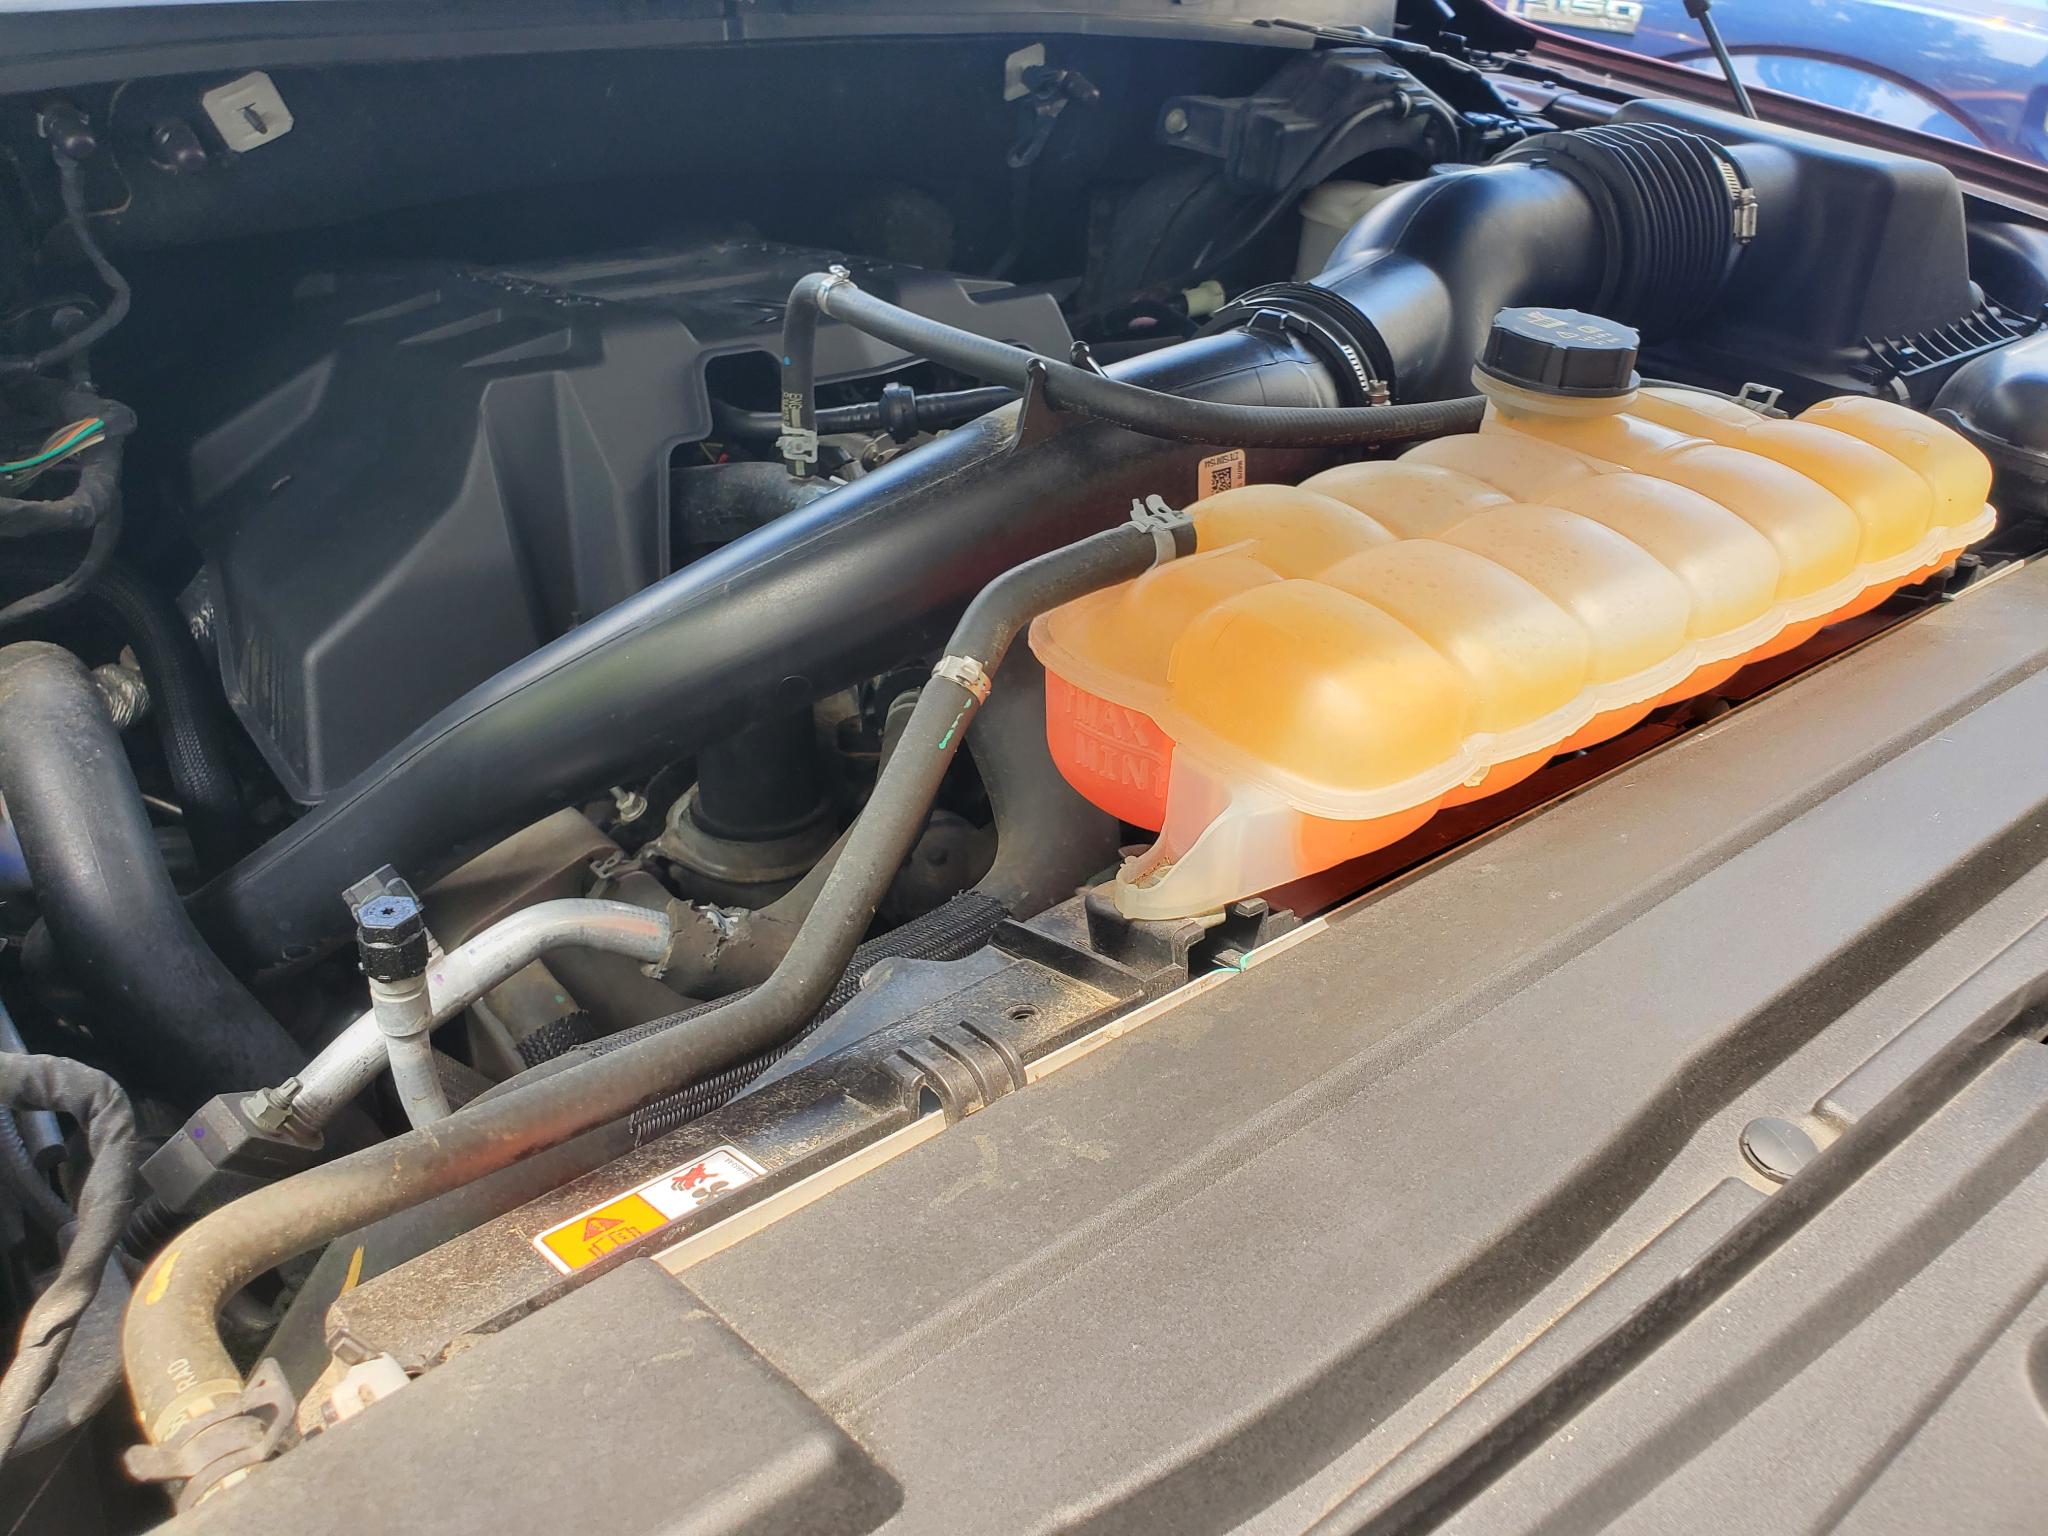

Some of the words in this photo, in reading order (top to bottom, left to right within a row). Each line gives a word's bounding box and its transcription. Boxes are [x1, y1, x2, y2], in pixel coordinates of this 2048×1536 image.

[1076, 690, 1149, 746] MAX
[1075, 732, 1149, 790] MIN
[167, 1358, 198, 1393] RAD
